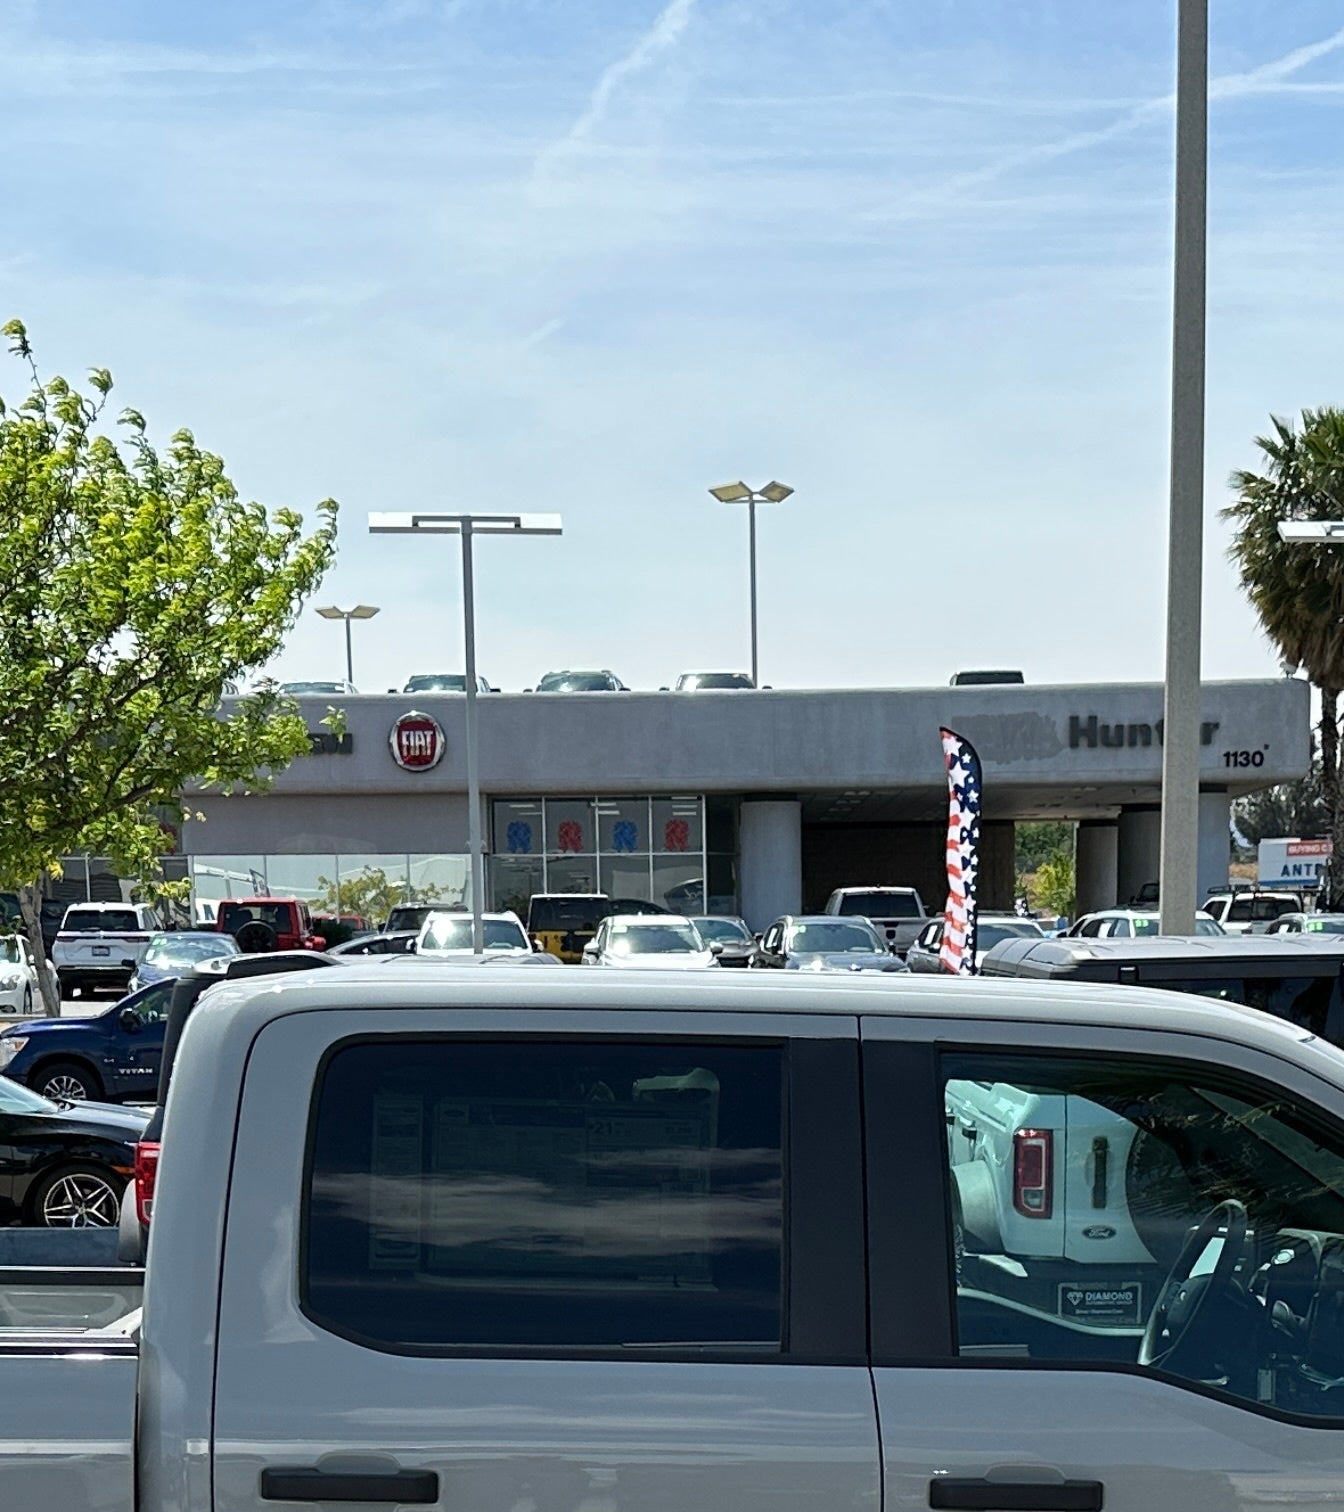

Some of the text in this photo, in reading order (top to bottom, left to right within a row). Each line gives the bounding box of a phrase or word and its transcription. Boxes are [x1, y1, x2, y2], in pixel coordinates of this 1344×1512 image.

[1069, 715, 1220, 748] Hunr
[402, 731, 433, 756] FIAT
[1223, 751, 1264, 767] 1130
[1085, 1291, 1133, 1300] DIAMOND
